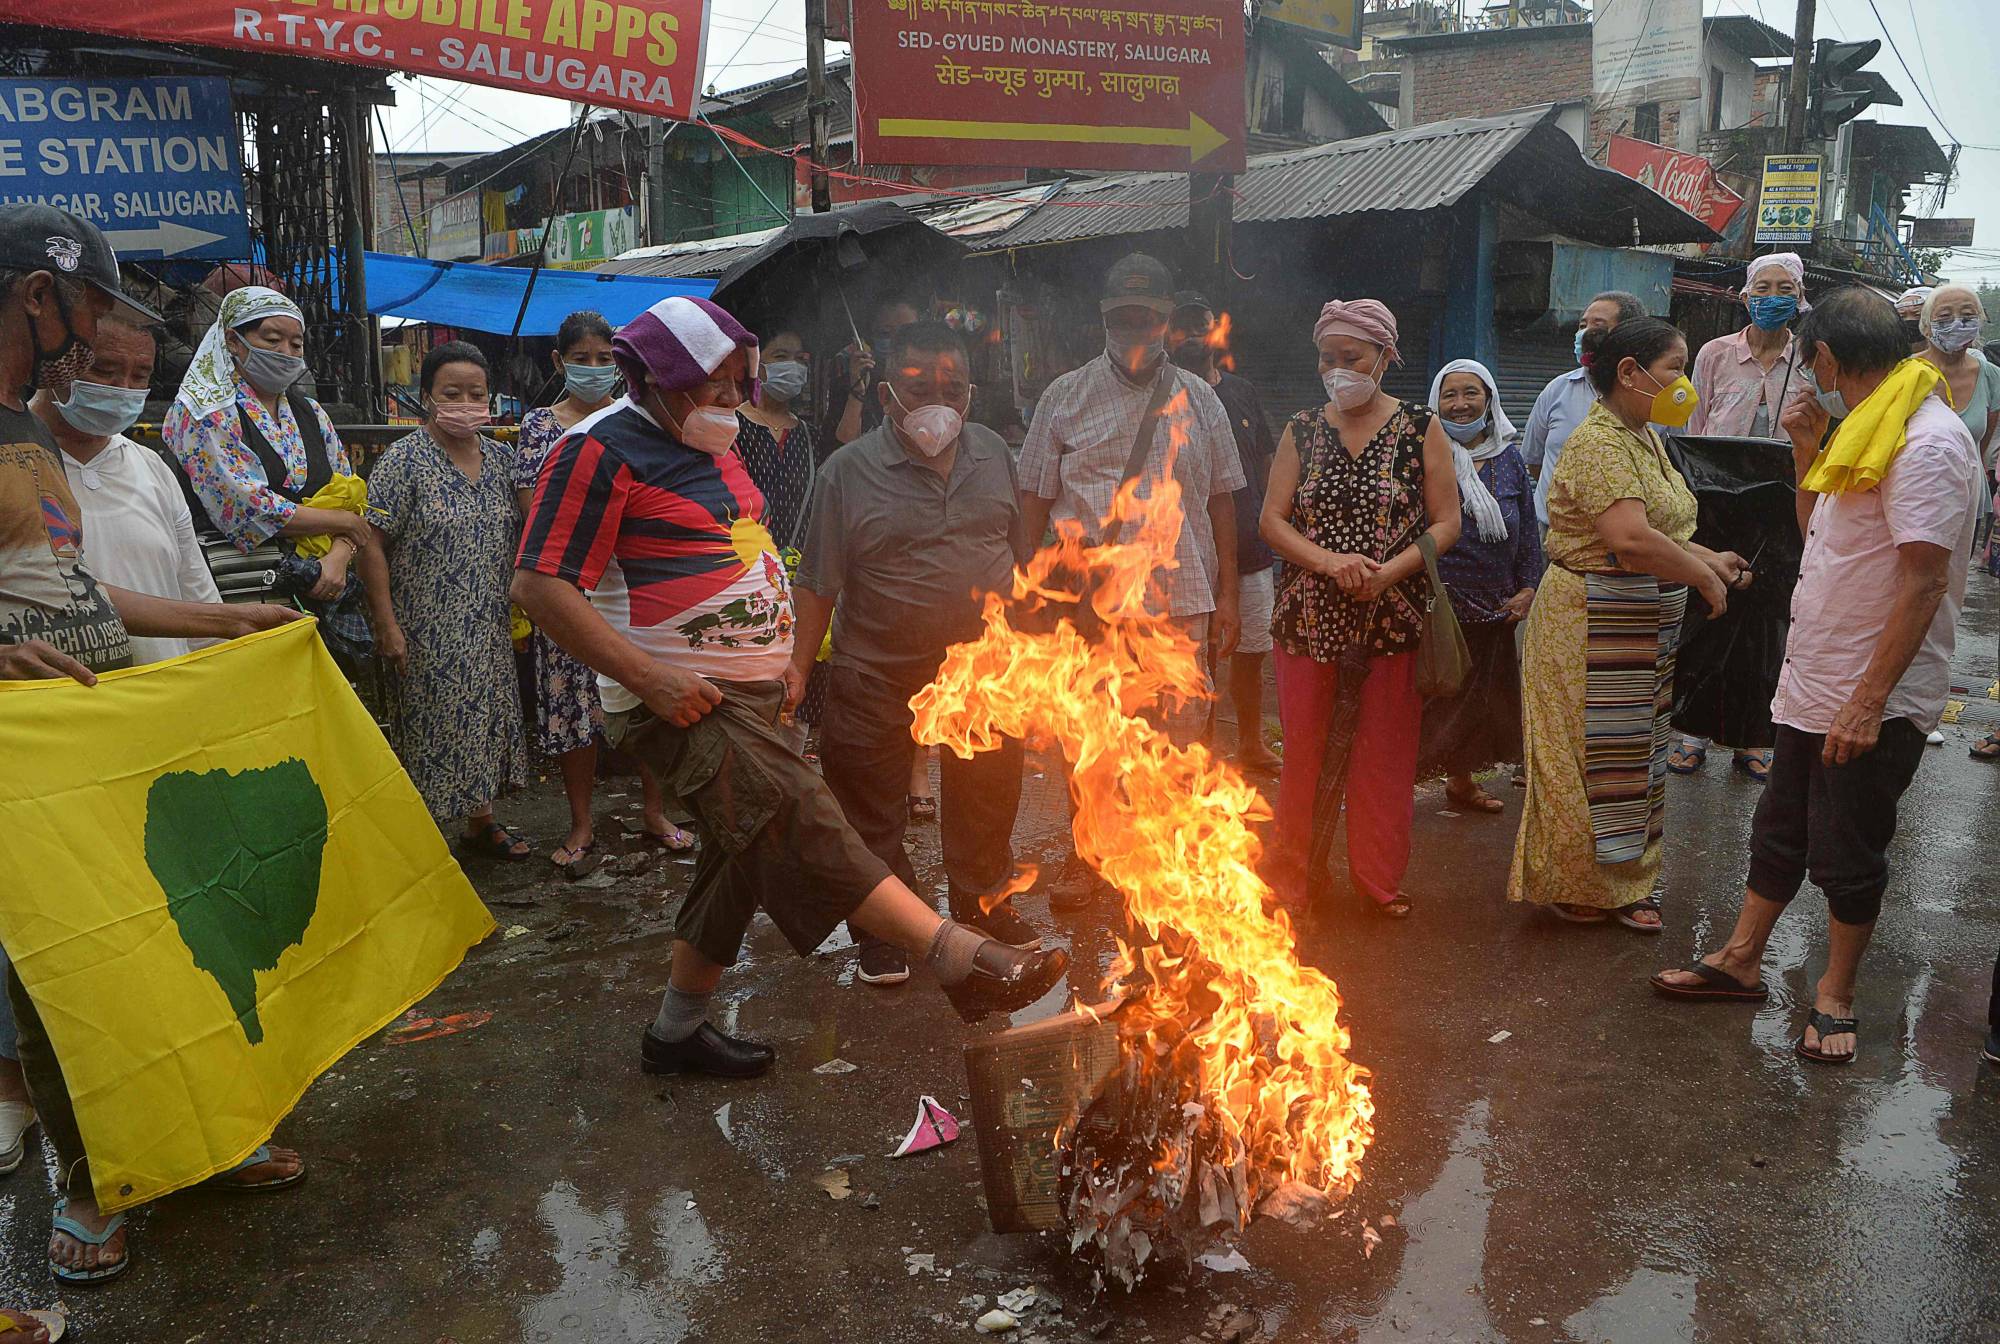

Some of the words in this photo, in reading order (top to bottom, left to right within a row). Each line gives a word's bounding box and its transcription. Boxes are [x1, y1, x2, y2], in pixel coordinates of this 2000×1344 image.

[542, 0, 679, 67] APPS
[898, 30, 1005, 52] SED-GYUED
[1010, 36, 1119, 61] MONASTERY,
[1125, 44, 1212, 65] SALUGARA
[233, 7, 395, 59] R.T.Y.C.
[438, 37, 675, 108] SALUGARA
[38, 136, 229, 176] STATION
[113, 190, 241, 218] SALUGARA
[94, 648, 107, 663] OF
